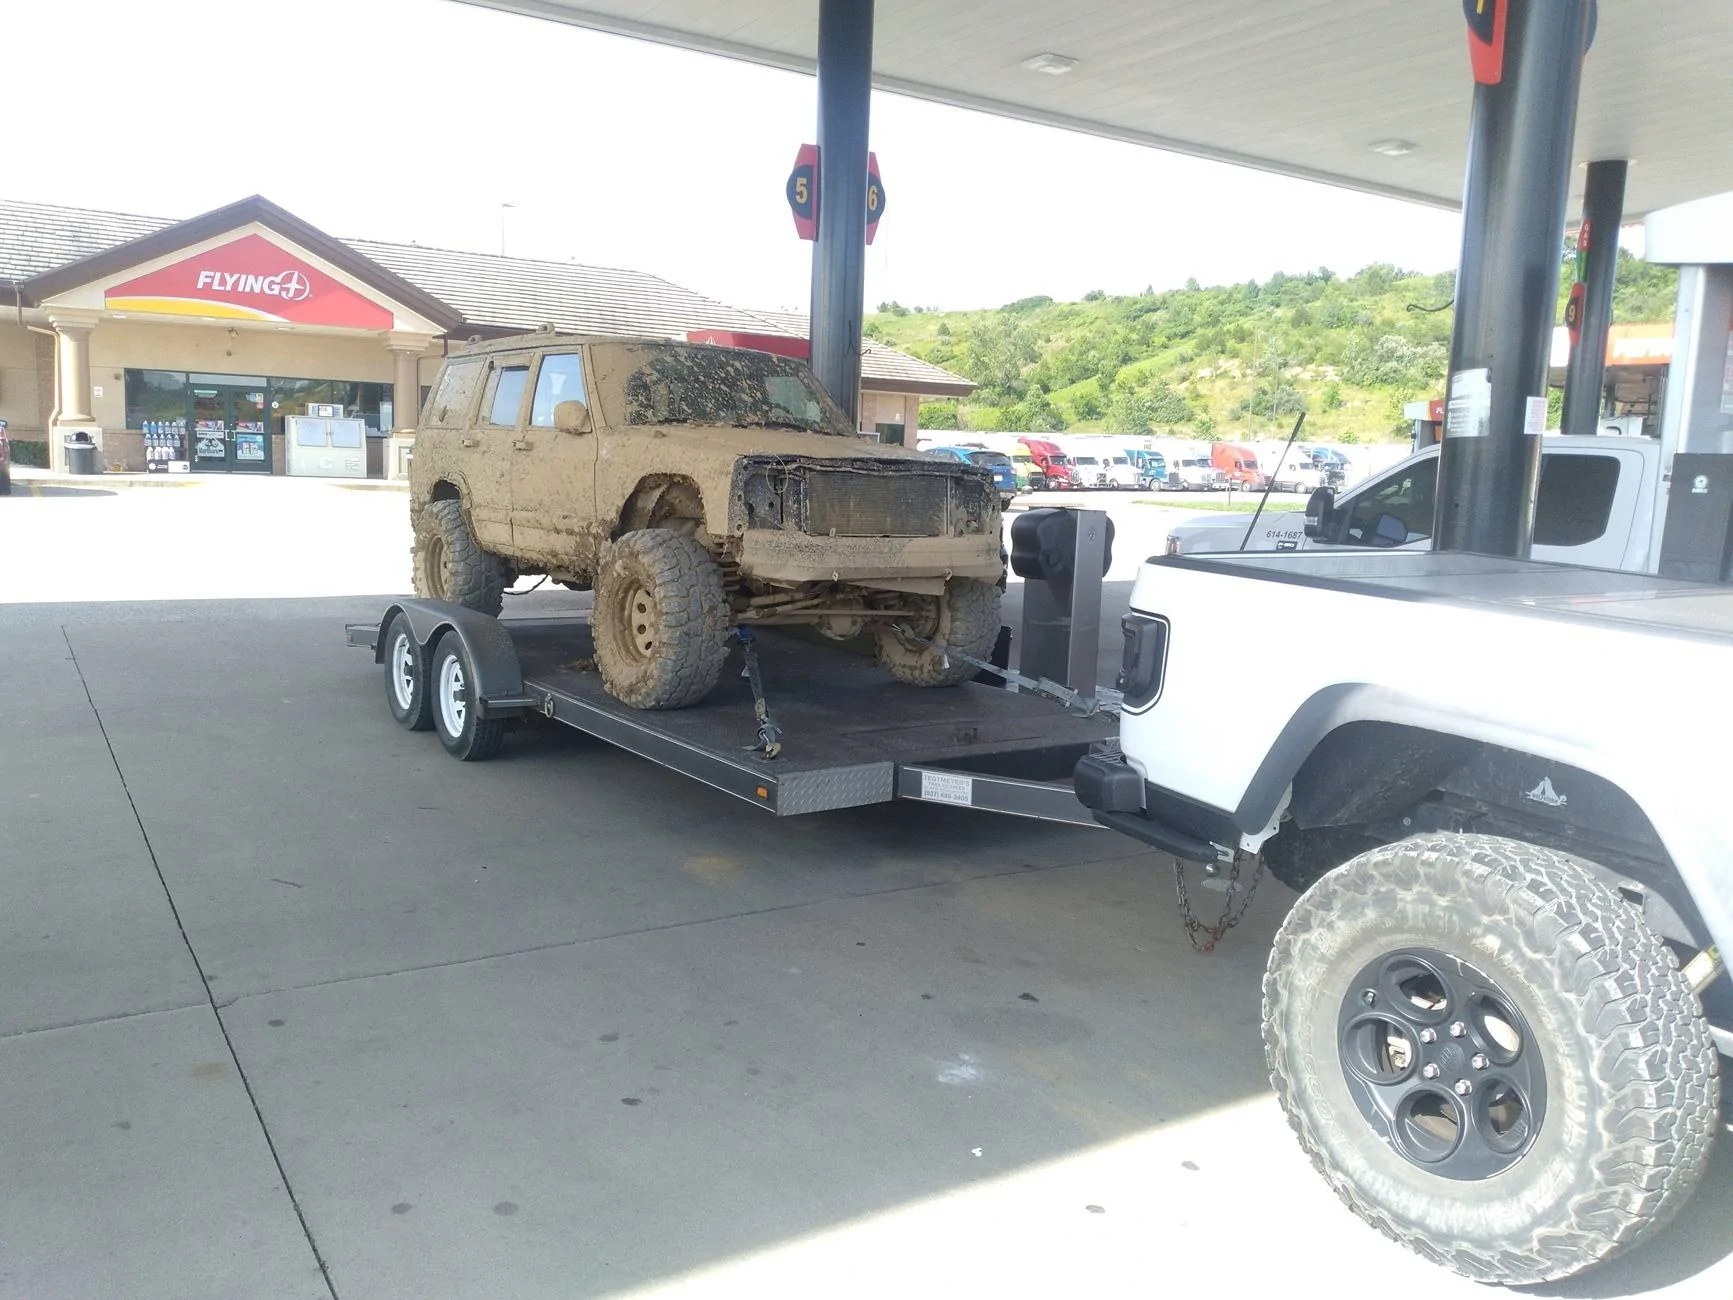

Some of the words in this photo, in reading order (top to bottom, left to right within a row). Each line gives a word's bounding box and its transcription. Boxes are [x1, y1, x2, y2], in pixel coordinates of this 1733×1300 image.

[795, 176, 808, 204] 5
[868, 185, 878, 211] 6
[197, 270, 281, 296] FLYING
[1569, 304, 1576, 321] 9
[1266, 530, 1303, 539] 614-1687
